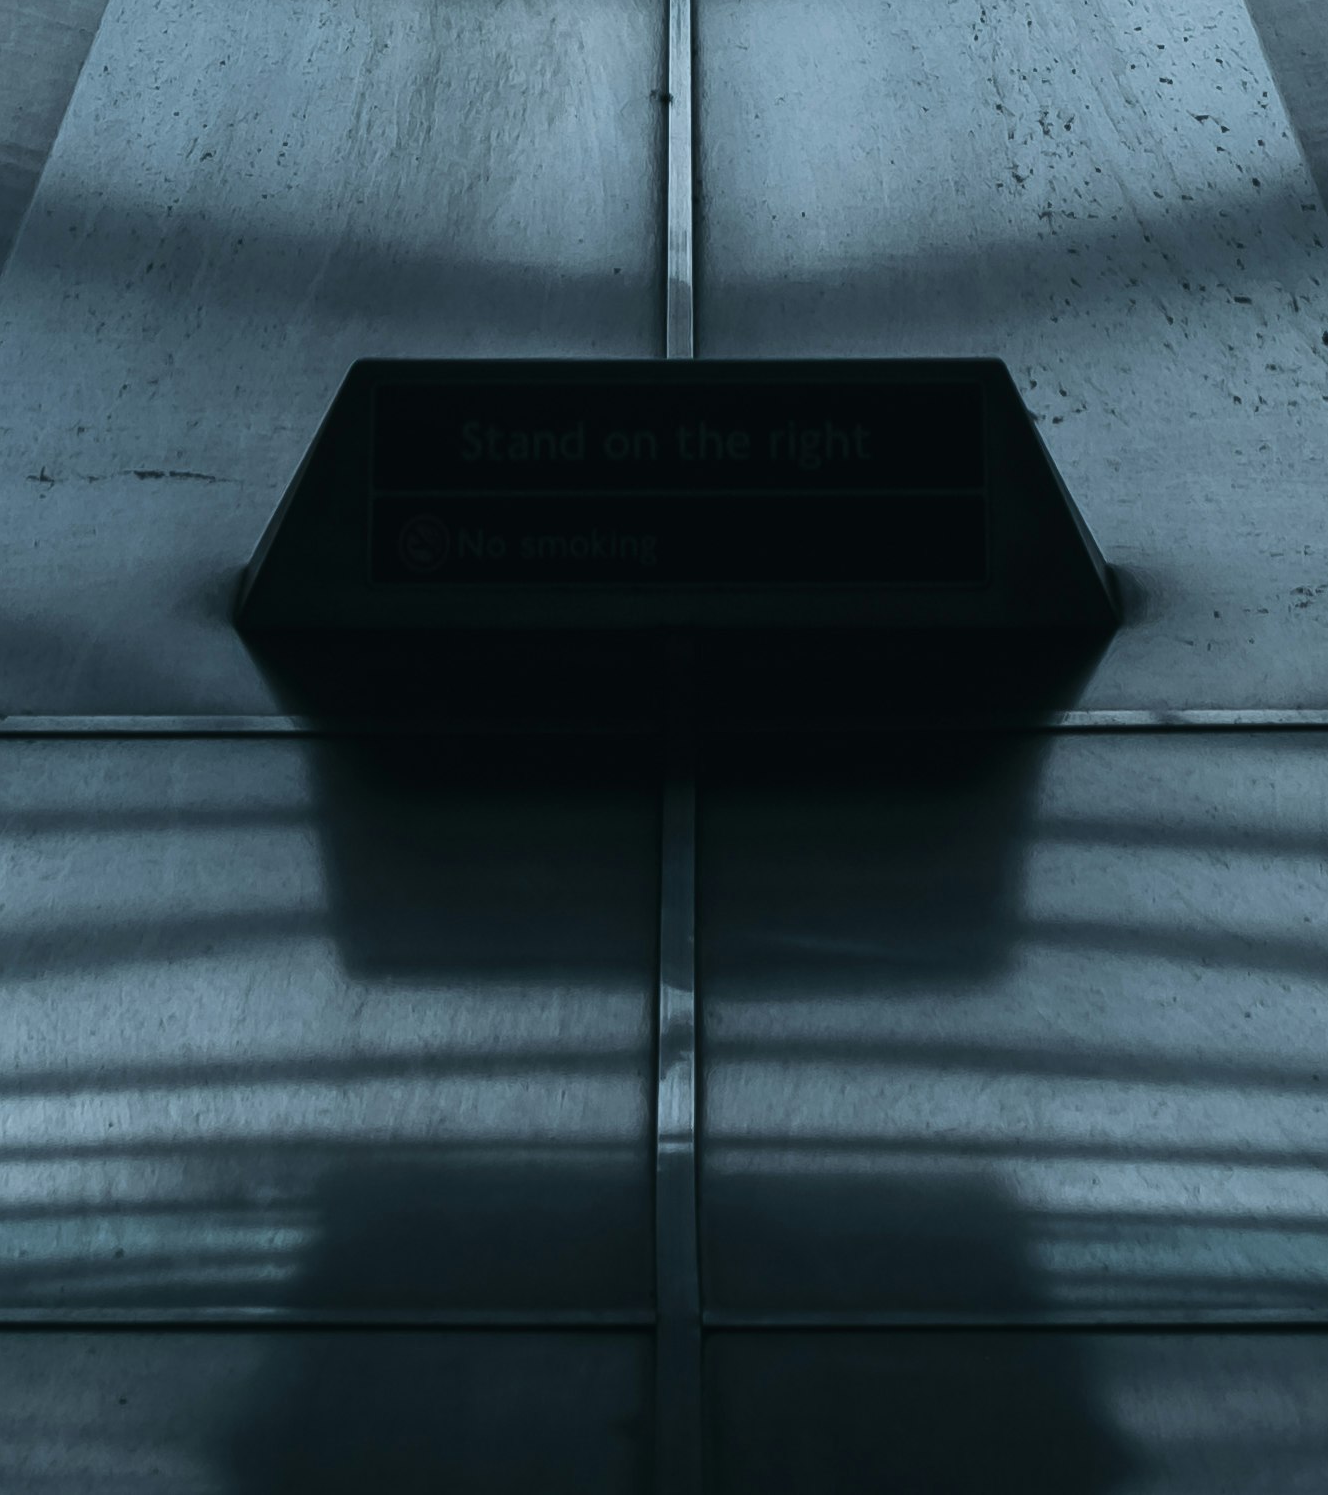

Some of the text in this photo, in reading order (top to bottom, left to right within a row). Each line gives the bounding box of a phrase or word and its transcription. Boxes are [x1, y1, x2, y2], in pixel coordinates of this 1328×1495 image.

[460, 419, 873, 471] Stand on the right
[457, 525, 659, 565] No smoking
